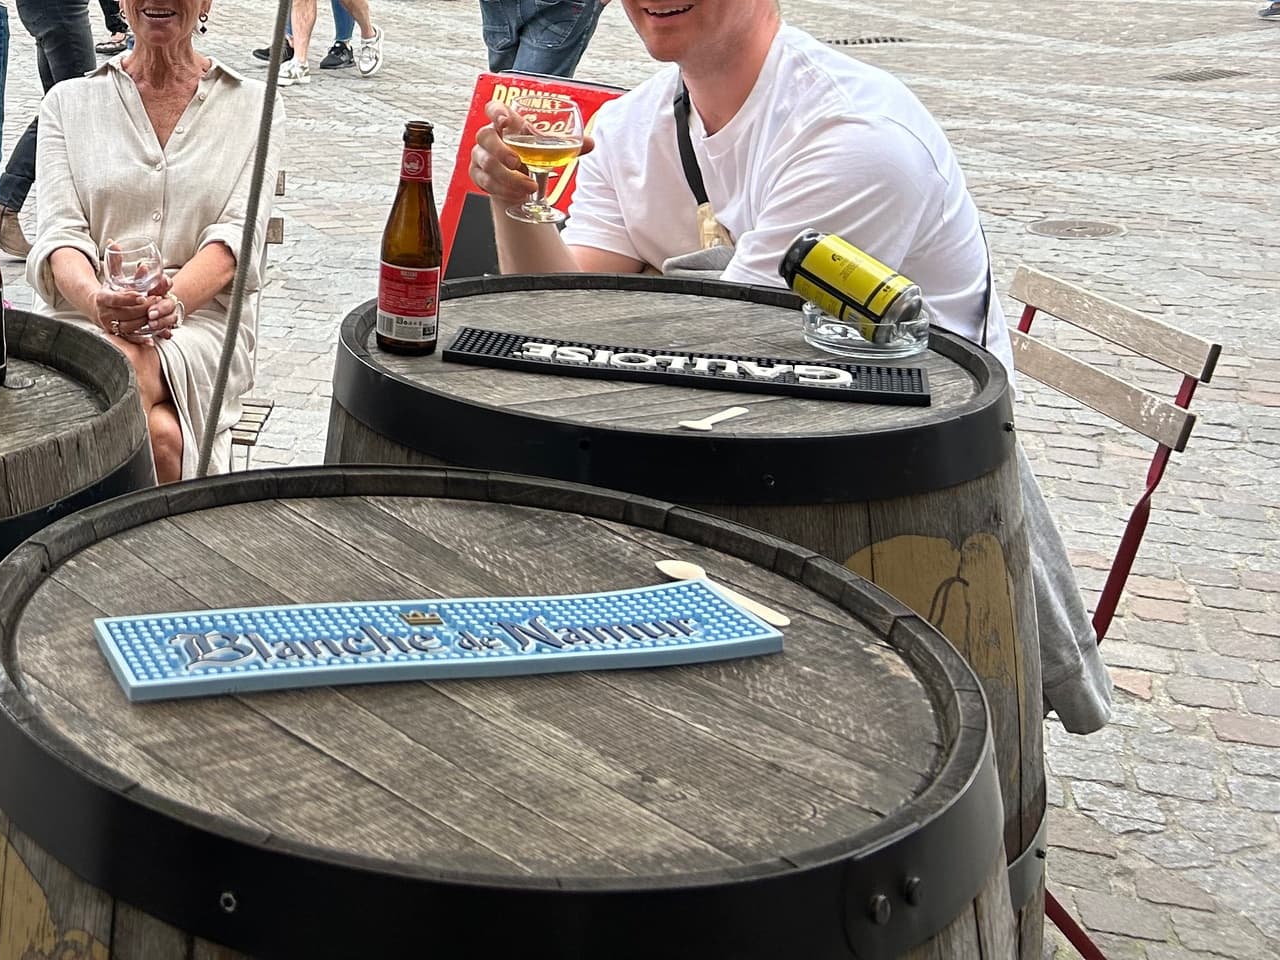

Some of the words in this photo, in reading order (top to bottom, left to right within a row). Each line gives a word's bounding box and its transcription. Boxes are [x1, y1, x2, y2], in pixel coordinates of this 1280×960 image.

[166, 623, 440, 672] Blanche
[456, 630, 499, 652] de
[498, 613, 705, 656] Namur
